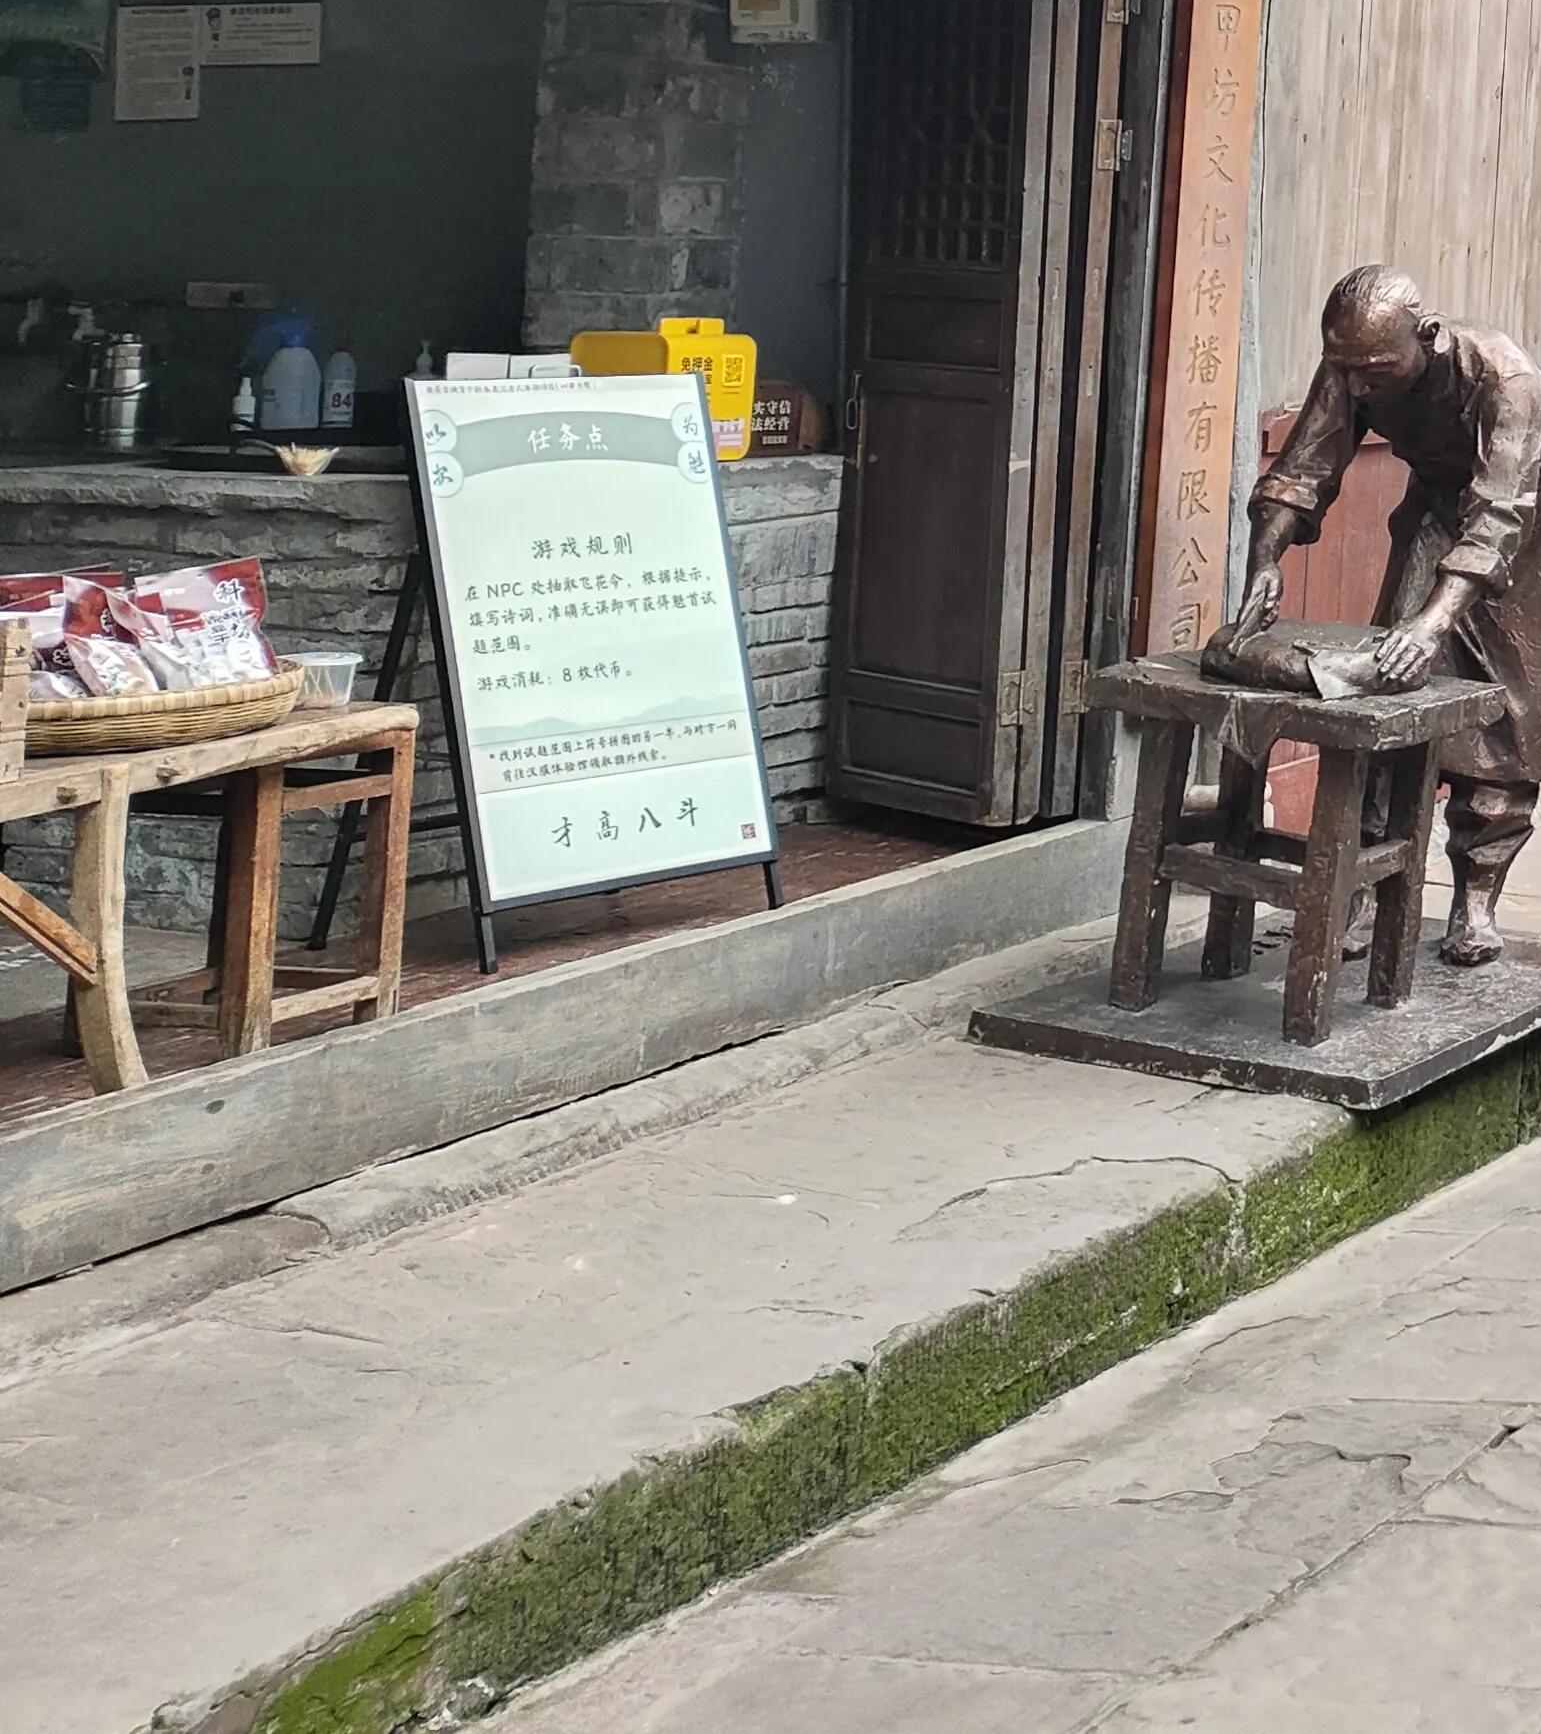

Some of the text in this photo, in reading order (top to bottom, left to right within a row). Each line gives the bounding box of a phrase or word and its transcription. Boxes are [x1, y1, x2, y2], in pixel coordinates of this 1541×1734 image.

[332, 393, 352, 408] 84
[527, 423, 608, 454] 任务点
[531, 532, 633, 559] 游戏规则
[487, 582, 524, 598] NPC
[551, 797, 698, 847] 才高八斗
